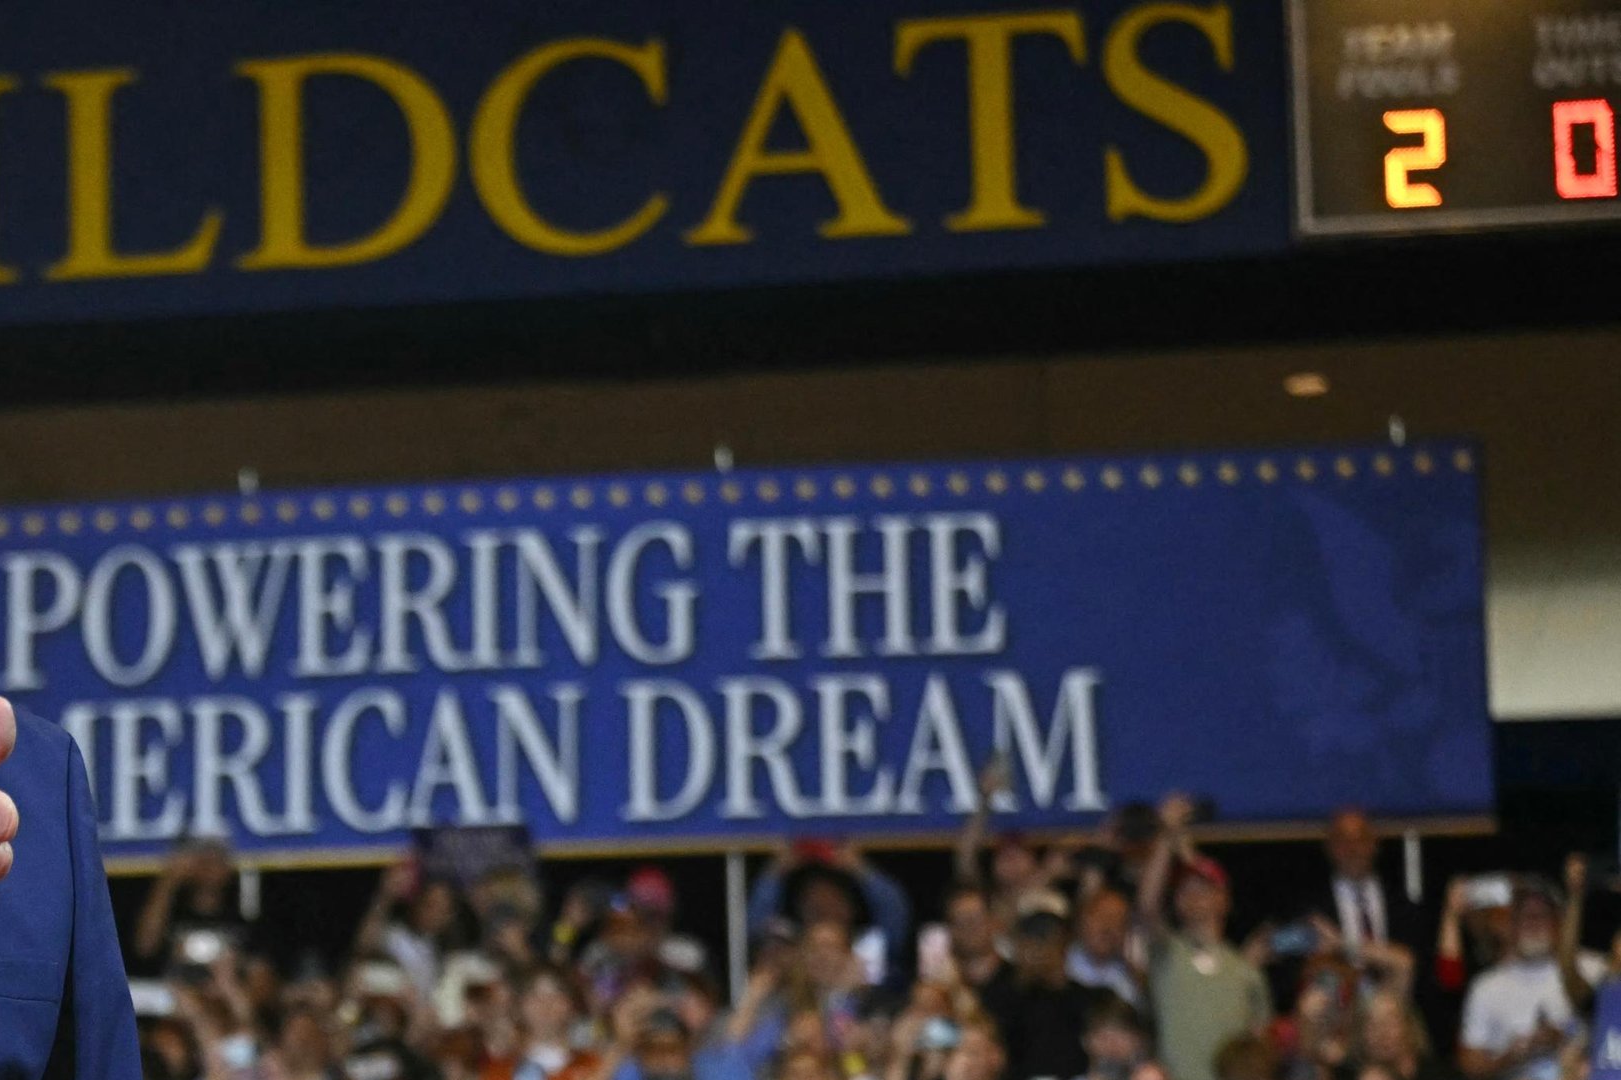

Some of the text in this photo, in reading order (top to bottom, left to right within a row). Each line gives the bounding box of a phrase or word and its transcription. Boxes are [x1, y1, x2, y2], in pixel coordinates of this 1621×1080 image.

[1382, 108, 1446, 208] 2
[1552, 98, 1618, 199] 0
[0, 511, 1008, 692] POWERING THE
[60, 666, 1108, 840] ERICAN DREAM
